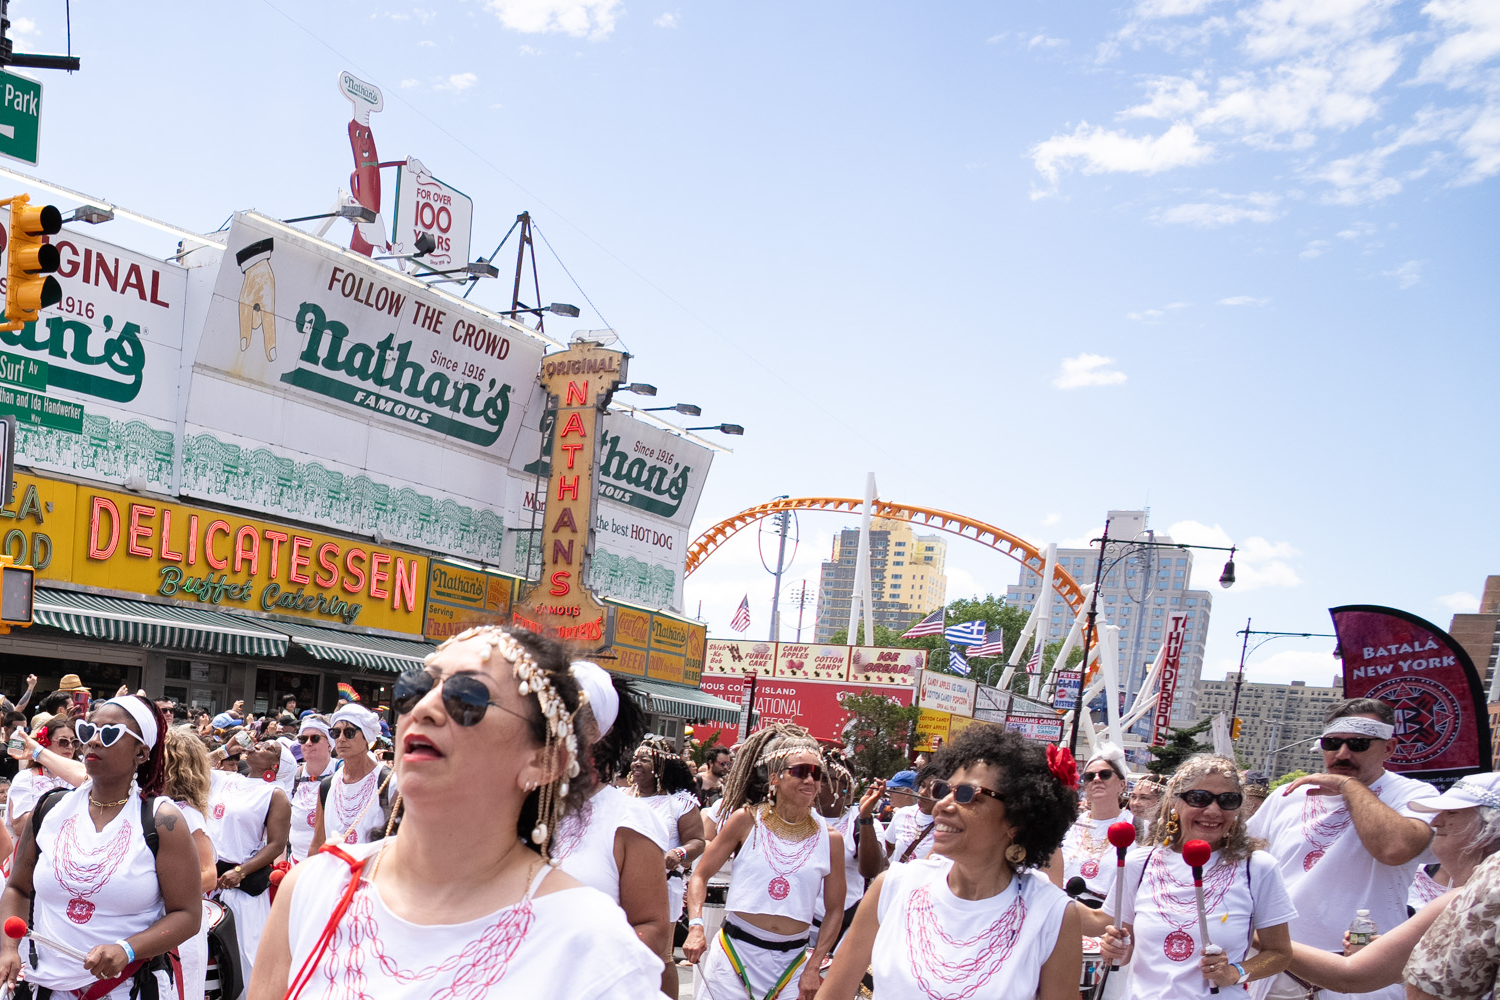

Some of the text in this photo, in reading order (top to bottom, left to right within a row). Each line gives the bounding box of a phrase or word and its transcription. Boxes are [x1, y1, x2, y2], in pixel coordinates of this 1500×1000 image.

[344, 75, 378, 102] Nathan's
[4, 82, 38, 117] Park
[416, 187, 452, 207] FOR OVER
[414, 200, 452, 234] 100
[327, 266, 511, 361] FOLLOW THE CROWD
[28, 360, 39, 375] Av
[295, 301, 512, 427] Nathan's
[430, 349, 487, 382] Since 1916
[545, 357, 618, 377] ORIGINAL
[16, 392, 29, 408] and
[30, 395, 42, 411] Ida
[43, 397, 82, 420] Handwerker
[353, 391, 433, 425] FAMOUS
[633, 440, 675, 465] Since 1916
[550, 379, 589, 597] NATHANS
[596, 514, 673, 550] the best HOT DOG
[87, 495, 418, 613] DELICATESSEN
[432, 568, 484, 596] Nathan's
[158, 565, 364, 626] Buffet Catering
[428, 605, 454, 619] Serving
[534, 604, 581, 617] FAMOUS
[652, 620, 687, 643] Nathan's
[708, 643, 726, 651] Shish
[744, 652, 773, 661] FUNNEL
[781, 651, 809, 660] APPLES
[783, 645, 810, 653] CANDY
[877, 651, 901, 662] ICE
[1362, 636, 1439, 661] BATALÁ
[619, 649, 647, 671] BEER
[710, 656, 723, 665] Bob
[748, 659, 769, 668] CAKE
[814, 655, 845, 664] COTTON
[815, 662, 843, 671] CANDY
[864, 662, 912, 675] CREAM
[1352, 655, 1457, 681] NEW YORK
[927, 677, 939, 687] CANDY
[939, 680, 951, 690] APPLES
[1059, 671, 1081, 679] PETE'S
[762, 686, 797, 696] ISLAND
[1008, 716, 1062, 726] WILLIAMS CANDY
[1034, 733, 1059, 741] POPCORN
